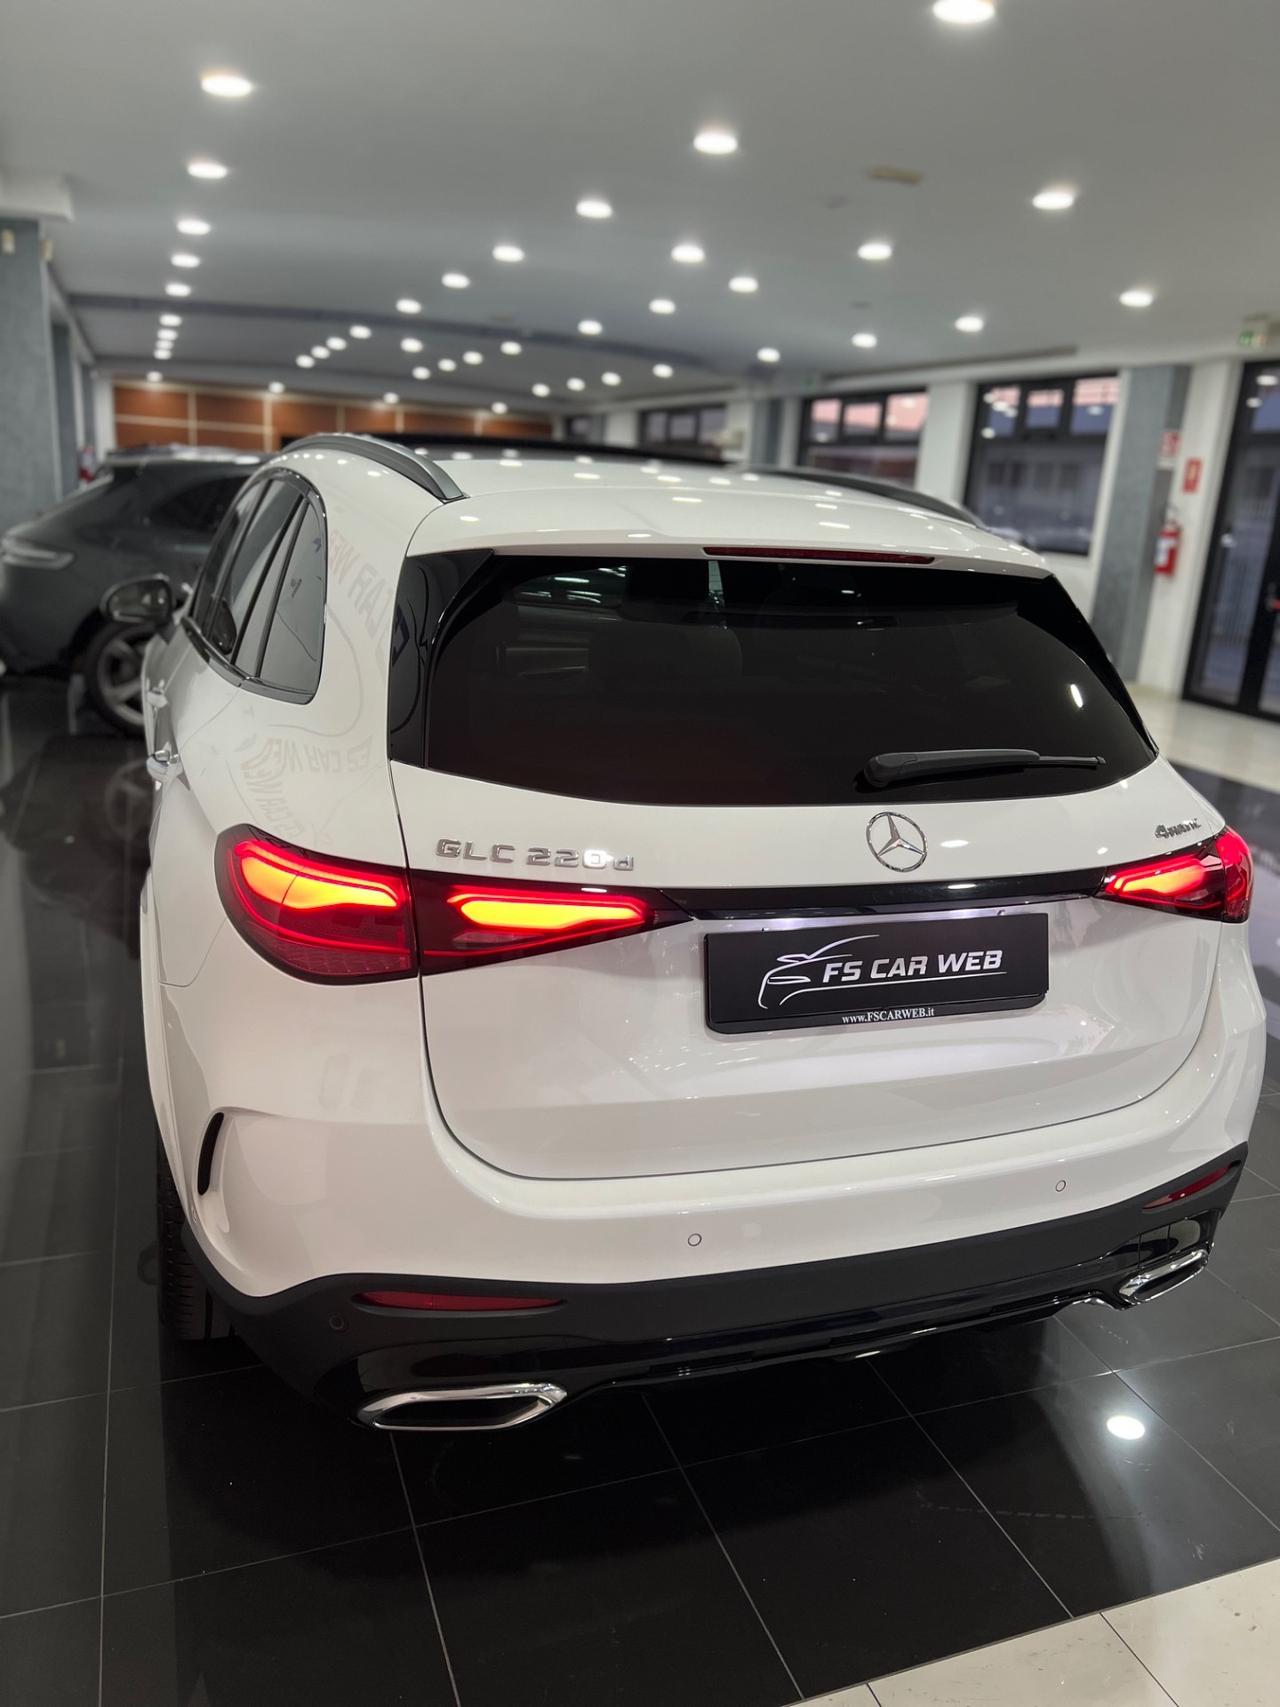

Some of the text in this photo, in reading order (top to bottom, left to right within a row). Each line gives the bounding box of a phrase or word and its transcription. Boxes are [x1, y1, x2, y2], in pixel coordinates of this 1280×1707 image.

[436, 838, 634, 871] GLC 220 d
[822, 949, 1003, 984] FS CAR WEB
[841, 1007, 936, 1025] www.FSCARWEB.it
